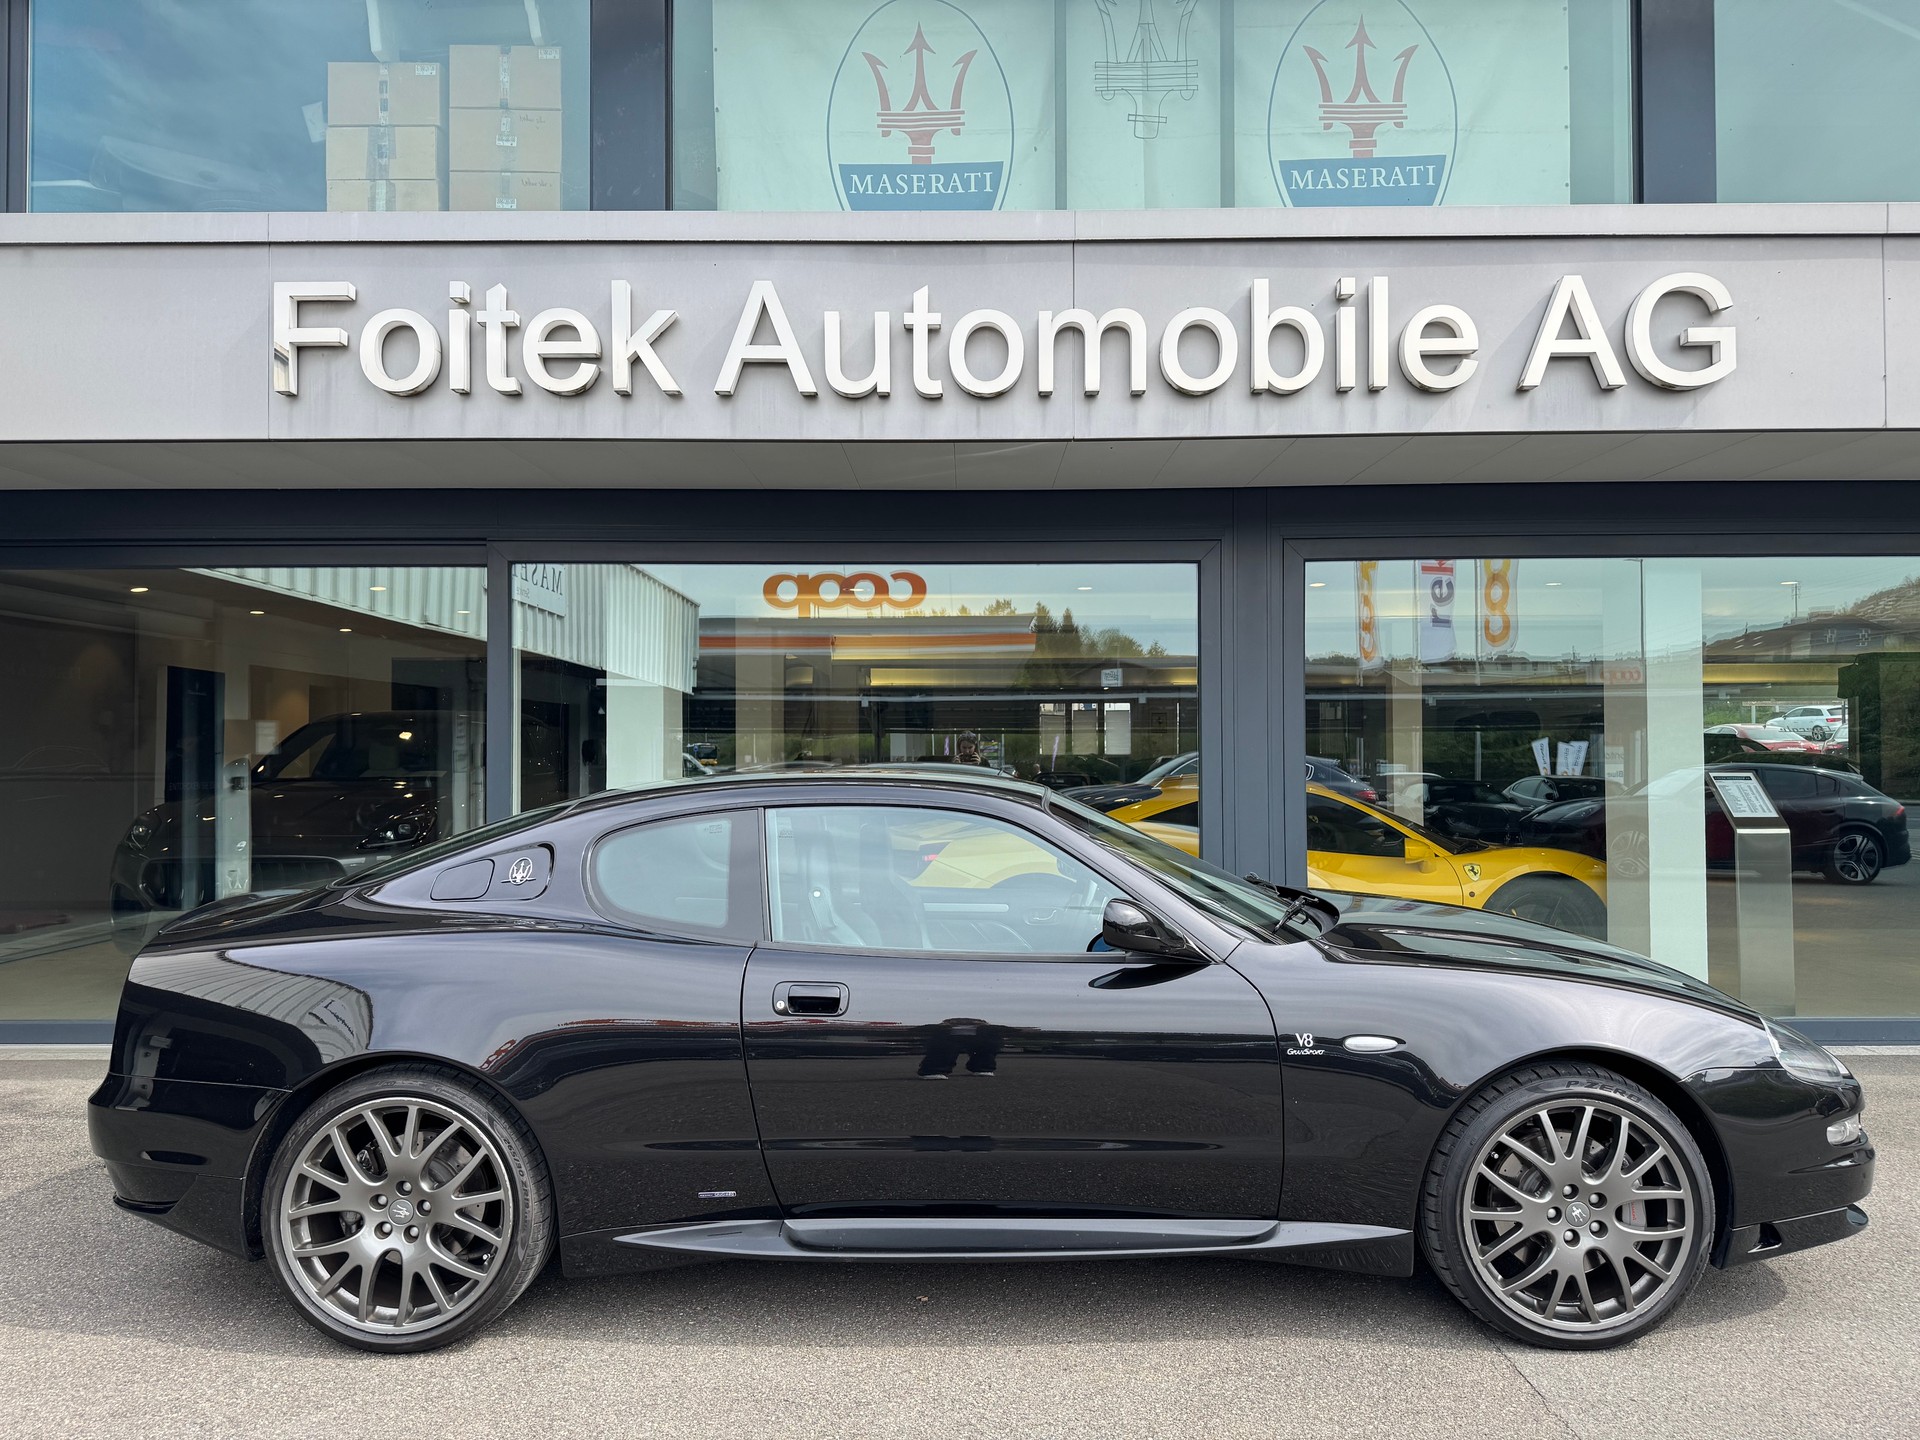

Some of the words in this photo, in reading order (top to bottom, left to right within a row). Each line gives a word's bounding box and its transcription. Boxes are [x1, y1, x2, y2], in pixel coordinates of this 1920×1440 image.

[849, 171, 993, 195] MASERATI
[1290, 165, 1437, 190] MASERATI
[273, 279, 683, 397] Foitek
[713, 275, 1479, 399] Automobile
[1516, 271, 1737, 392] AG
[1295, 1032, 1314, 1047] V8
